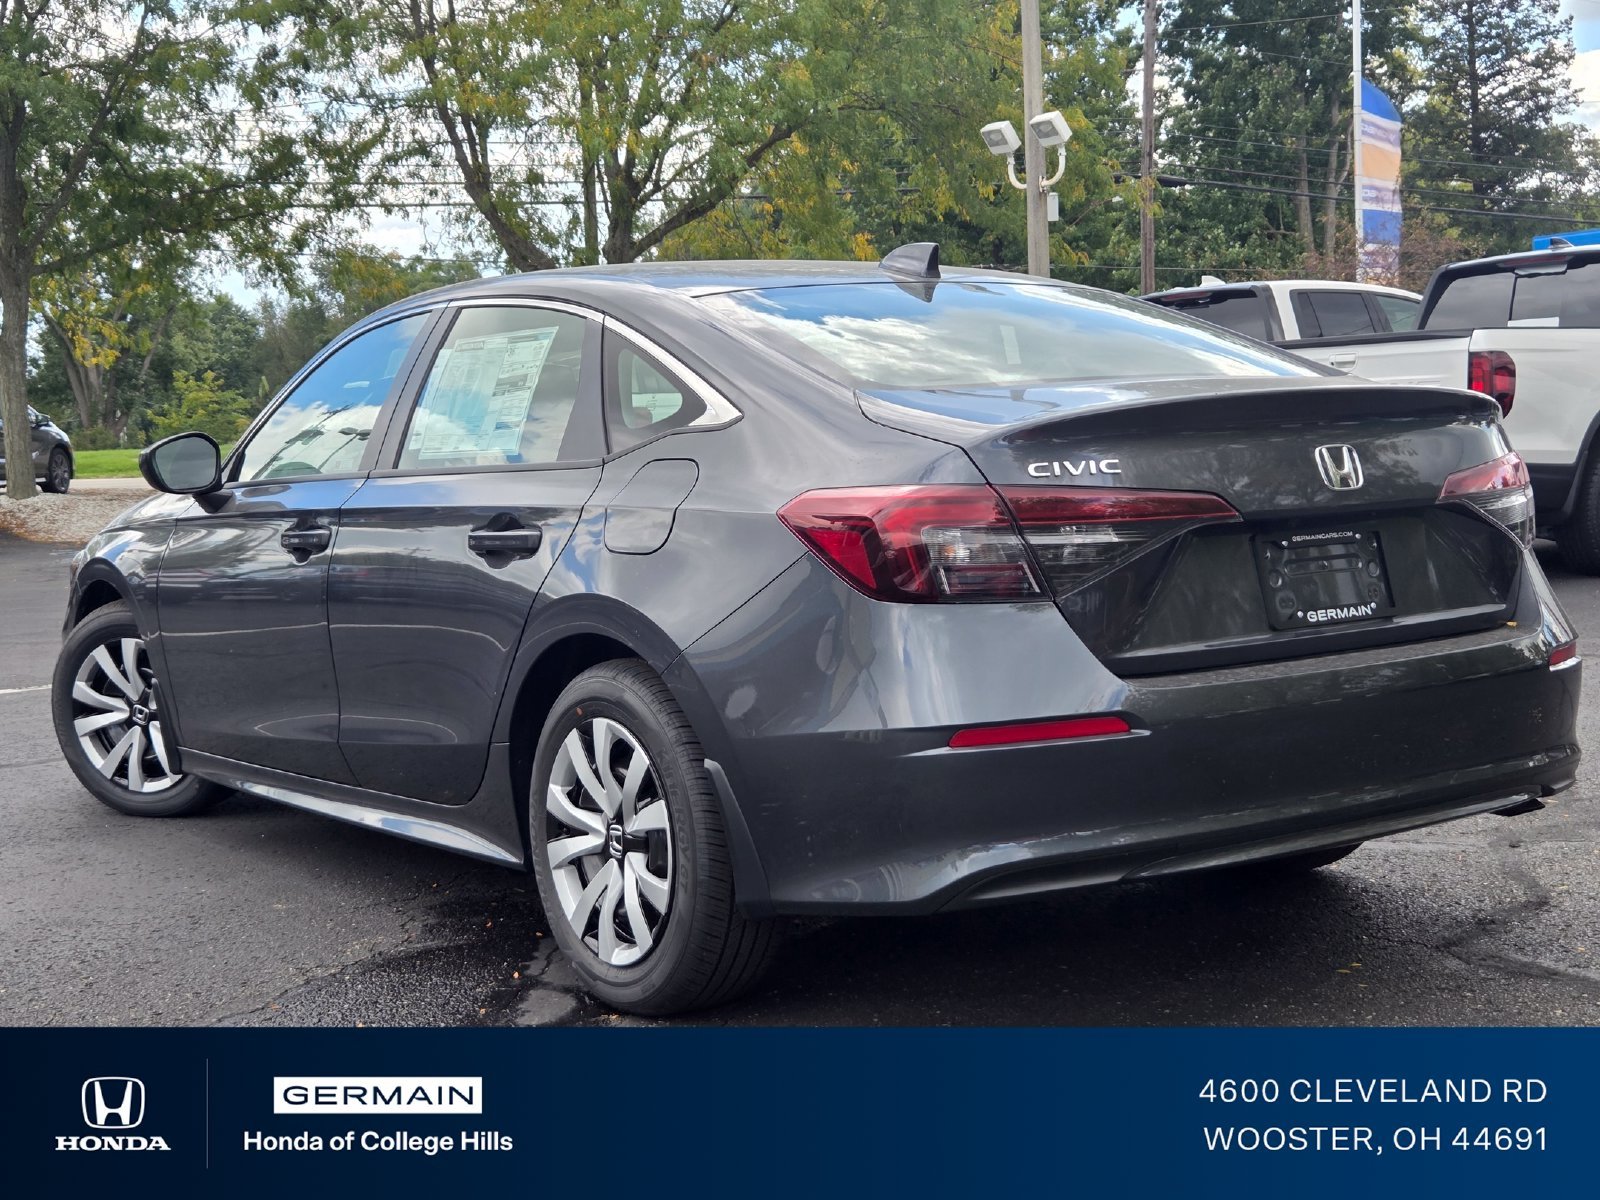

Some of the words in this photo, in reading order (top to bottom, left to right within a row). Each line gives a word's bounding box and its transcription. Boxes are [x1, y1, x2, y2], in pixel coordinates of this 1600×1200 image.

[1027, 458, 1122, 477] CIVIC
[1291, 531, 1353, 542] GERMAINCARS.COM
[1306, 604, 1372, 622] GERMAIN
